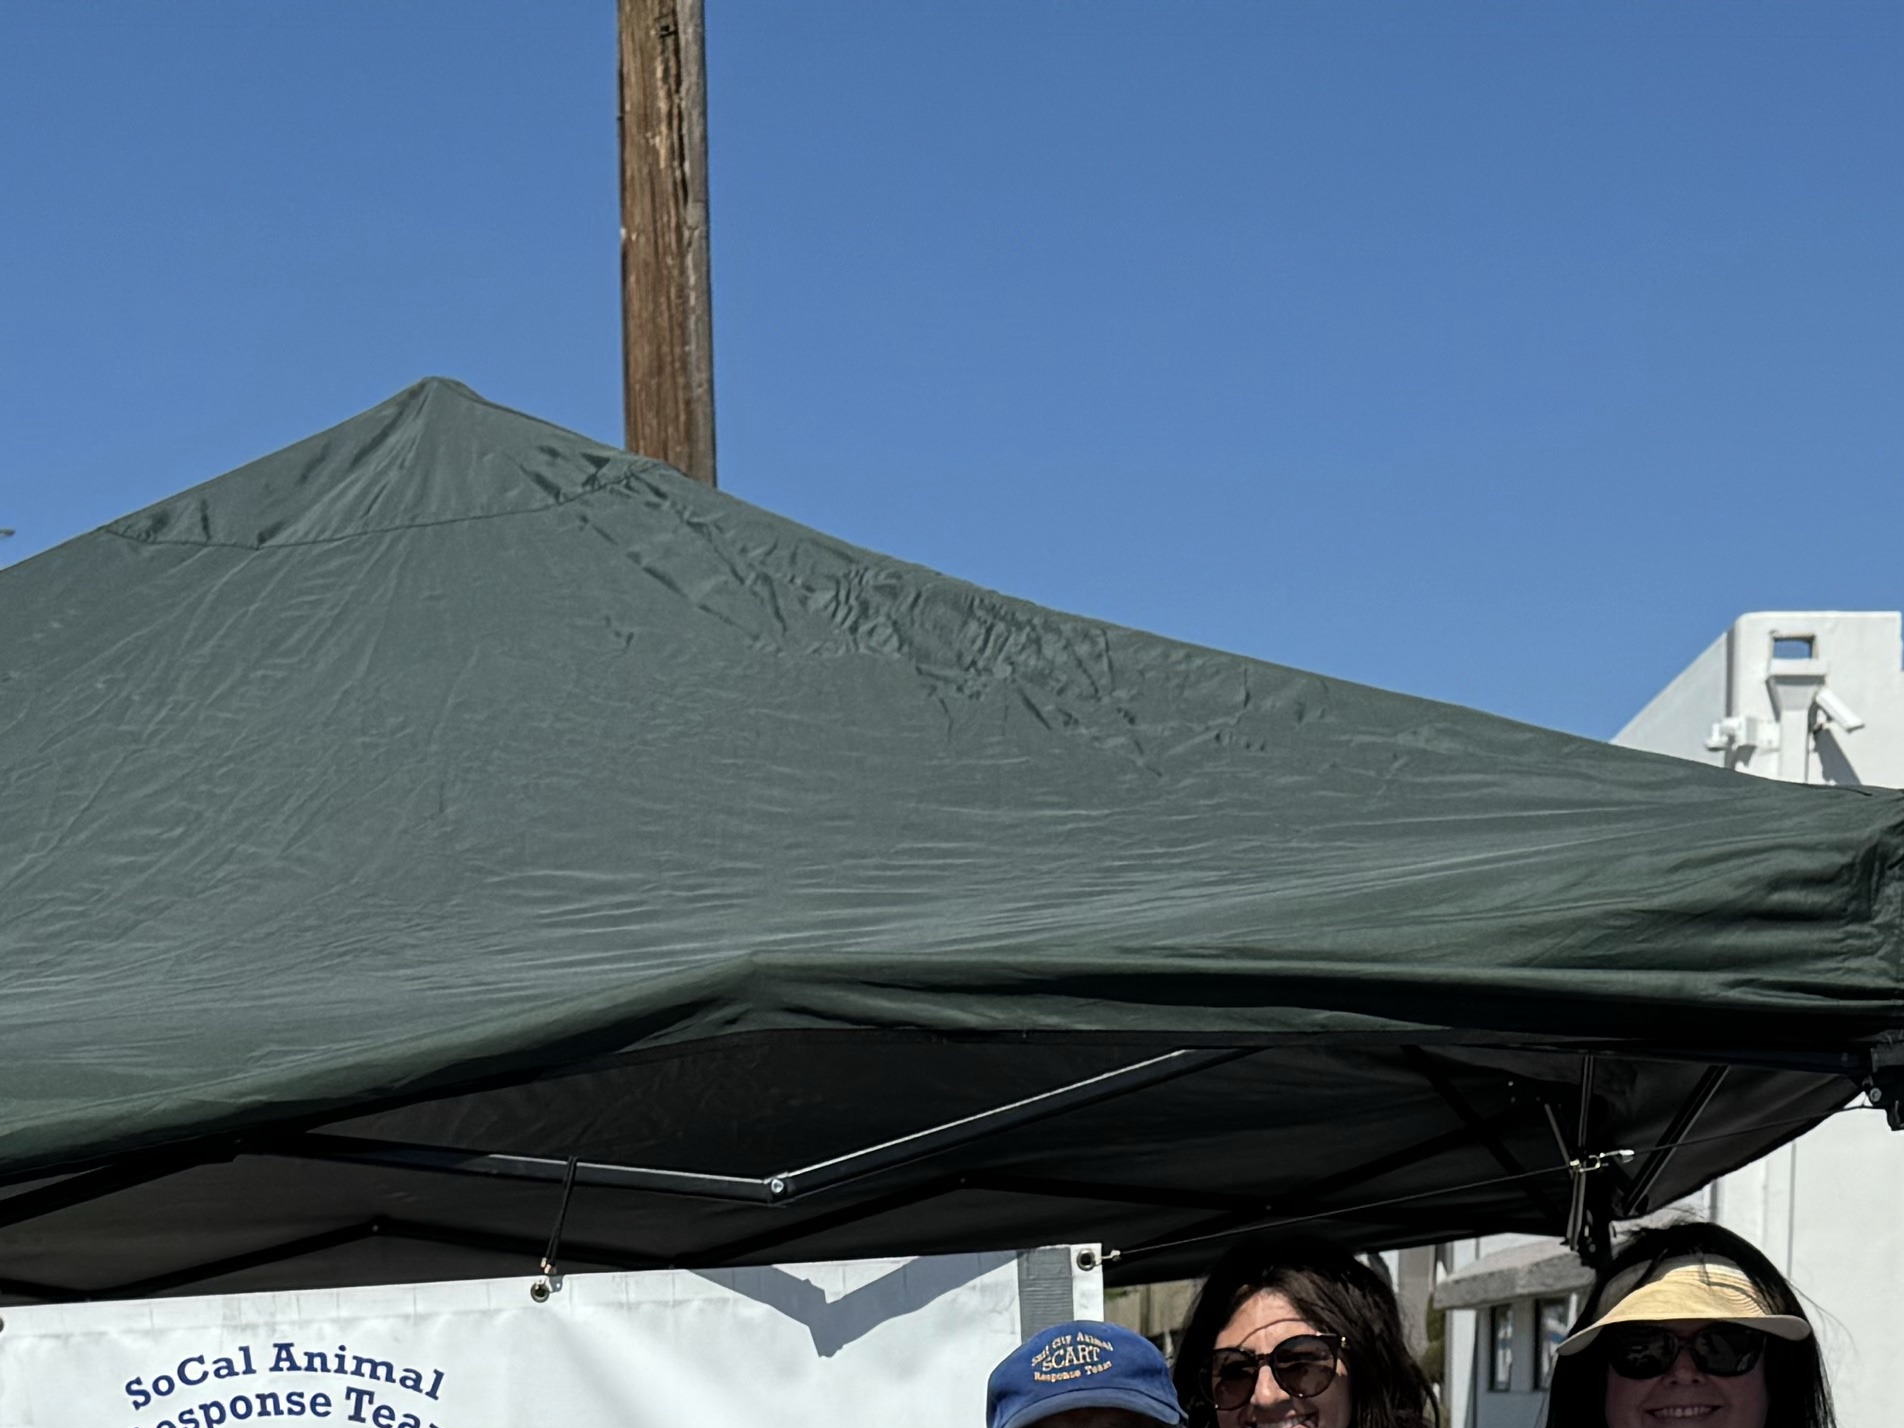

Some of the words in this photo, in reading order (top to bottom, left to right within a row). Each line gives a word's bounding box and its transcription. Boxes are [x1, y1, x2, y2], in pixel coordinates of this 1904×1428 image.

[1042, 1344, 1100, 1371] SCART
[124, 1345, 257, 1411] SoCal
[269, 1342, 445, 1401] Animal
[1034, 1370, 1082, 1382] Response
[1085, 1361, 1112, 1375] Team
